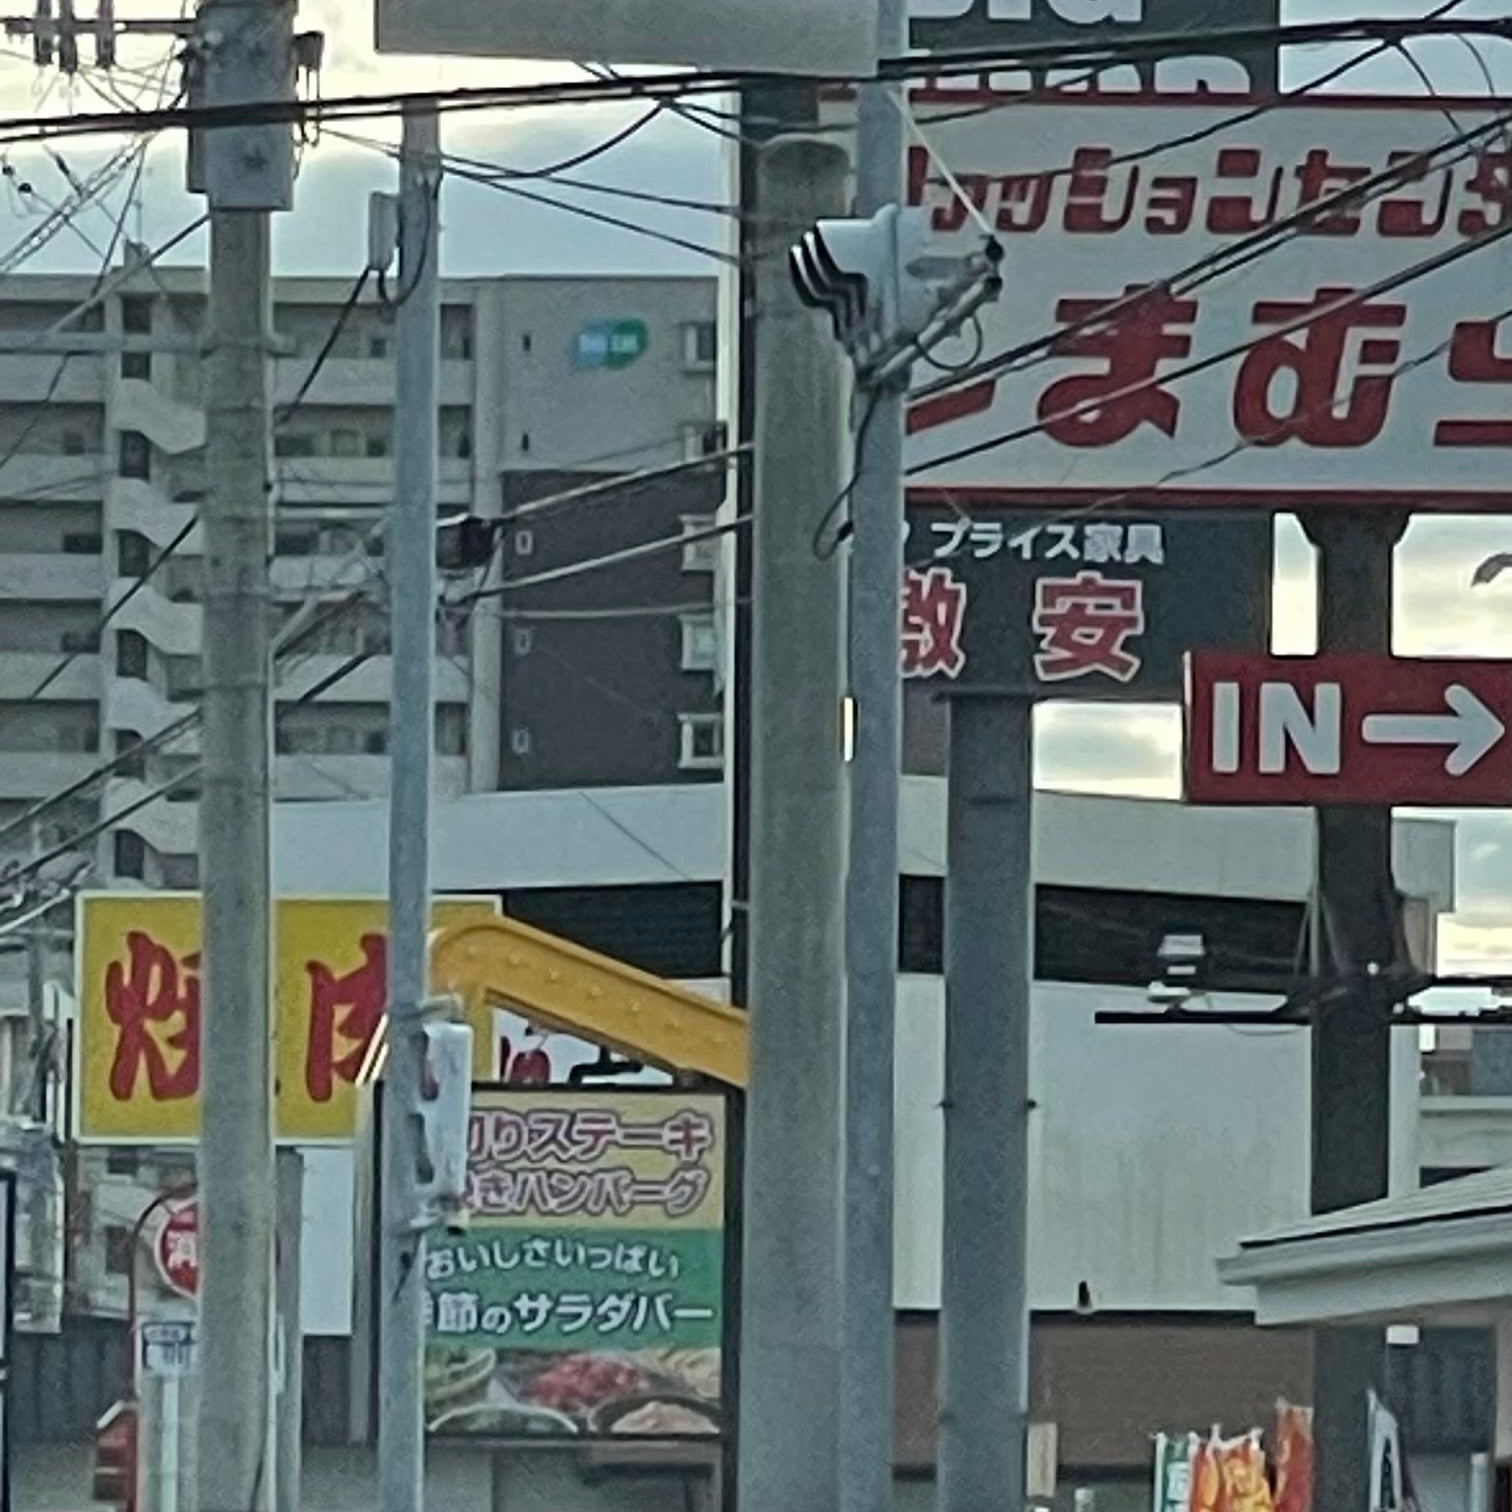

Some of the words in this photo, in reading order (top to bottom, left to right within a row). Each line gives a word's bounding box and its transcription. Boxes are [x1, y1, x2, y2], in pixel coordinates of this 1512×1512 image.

[901, 520, 1166, 565] プライス家具
[1210, 681, 1342, 776] IN
[466, 1164, 711, 1219] きハンバーグ
[426, 1236, 680, 1281] おいしさいっぱい
[421, 1289, 715, 1335] 節のサラダバー
